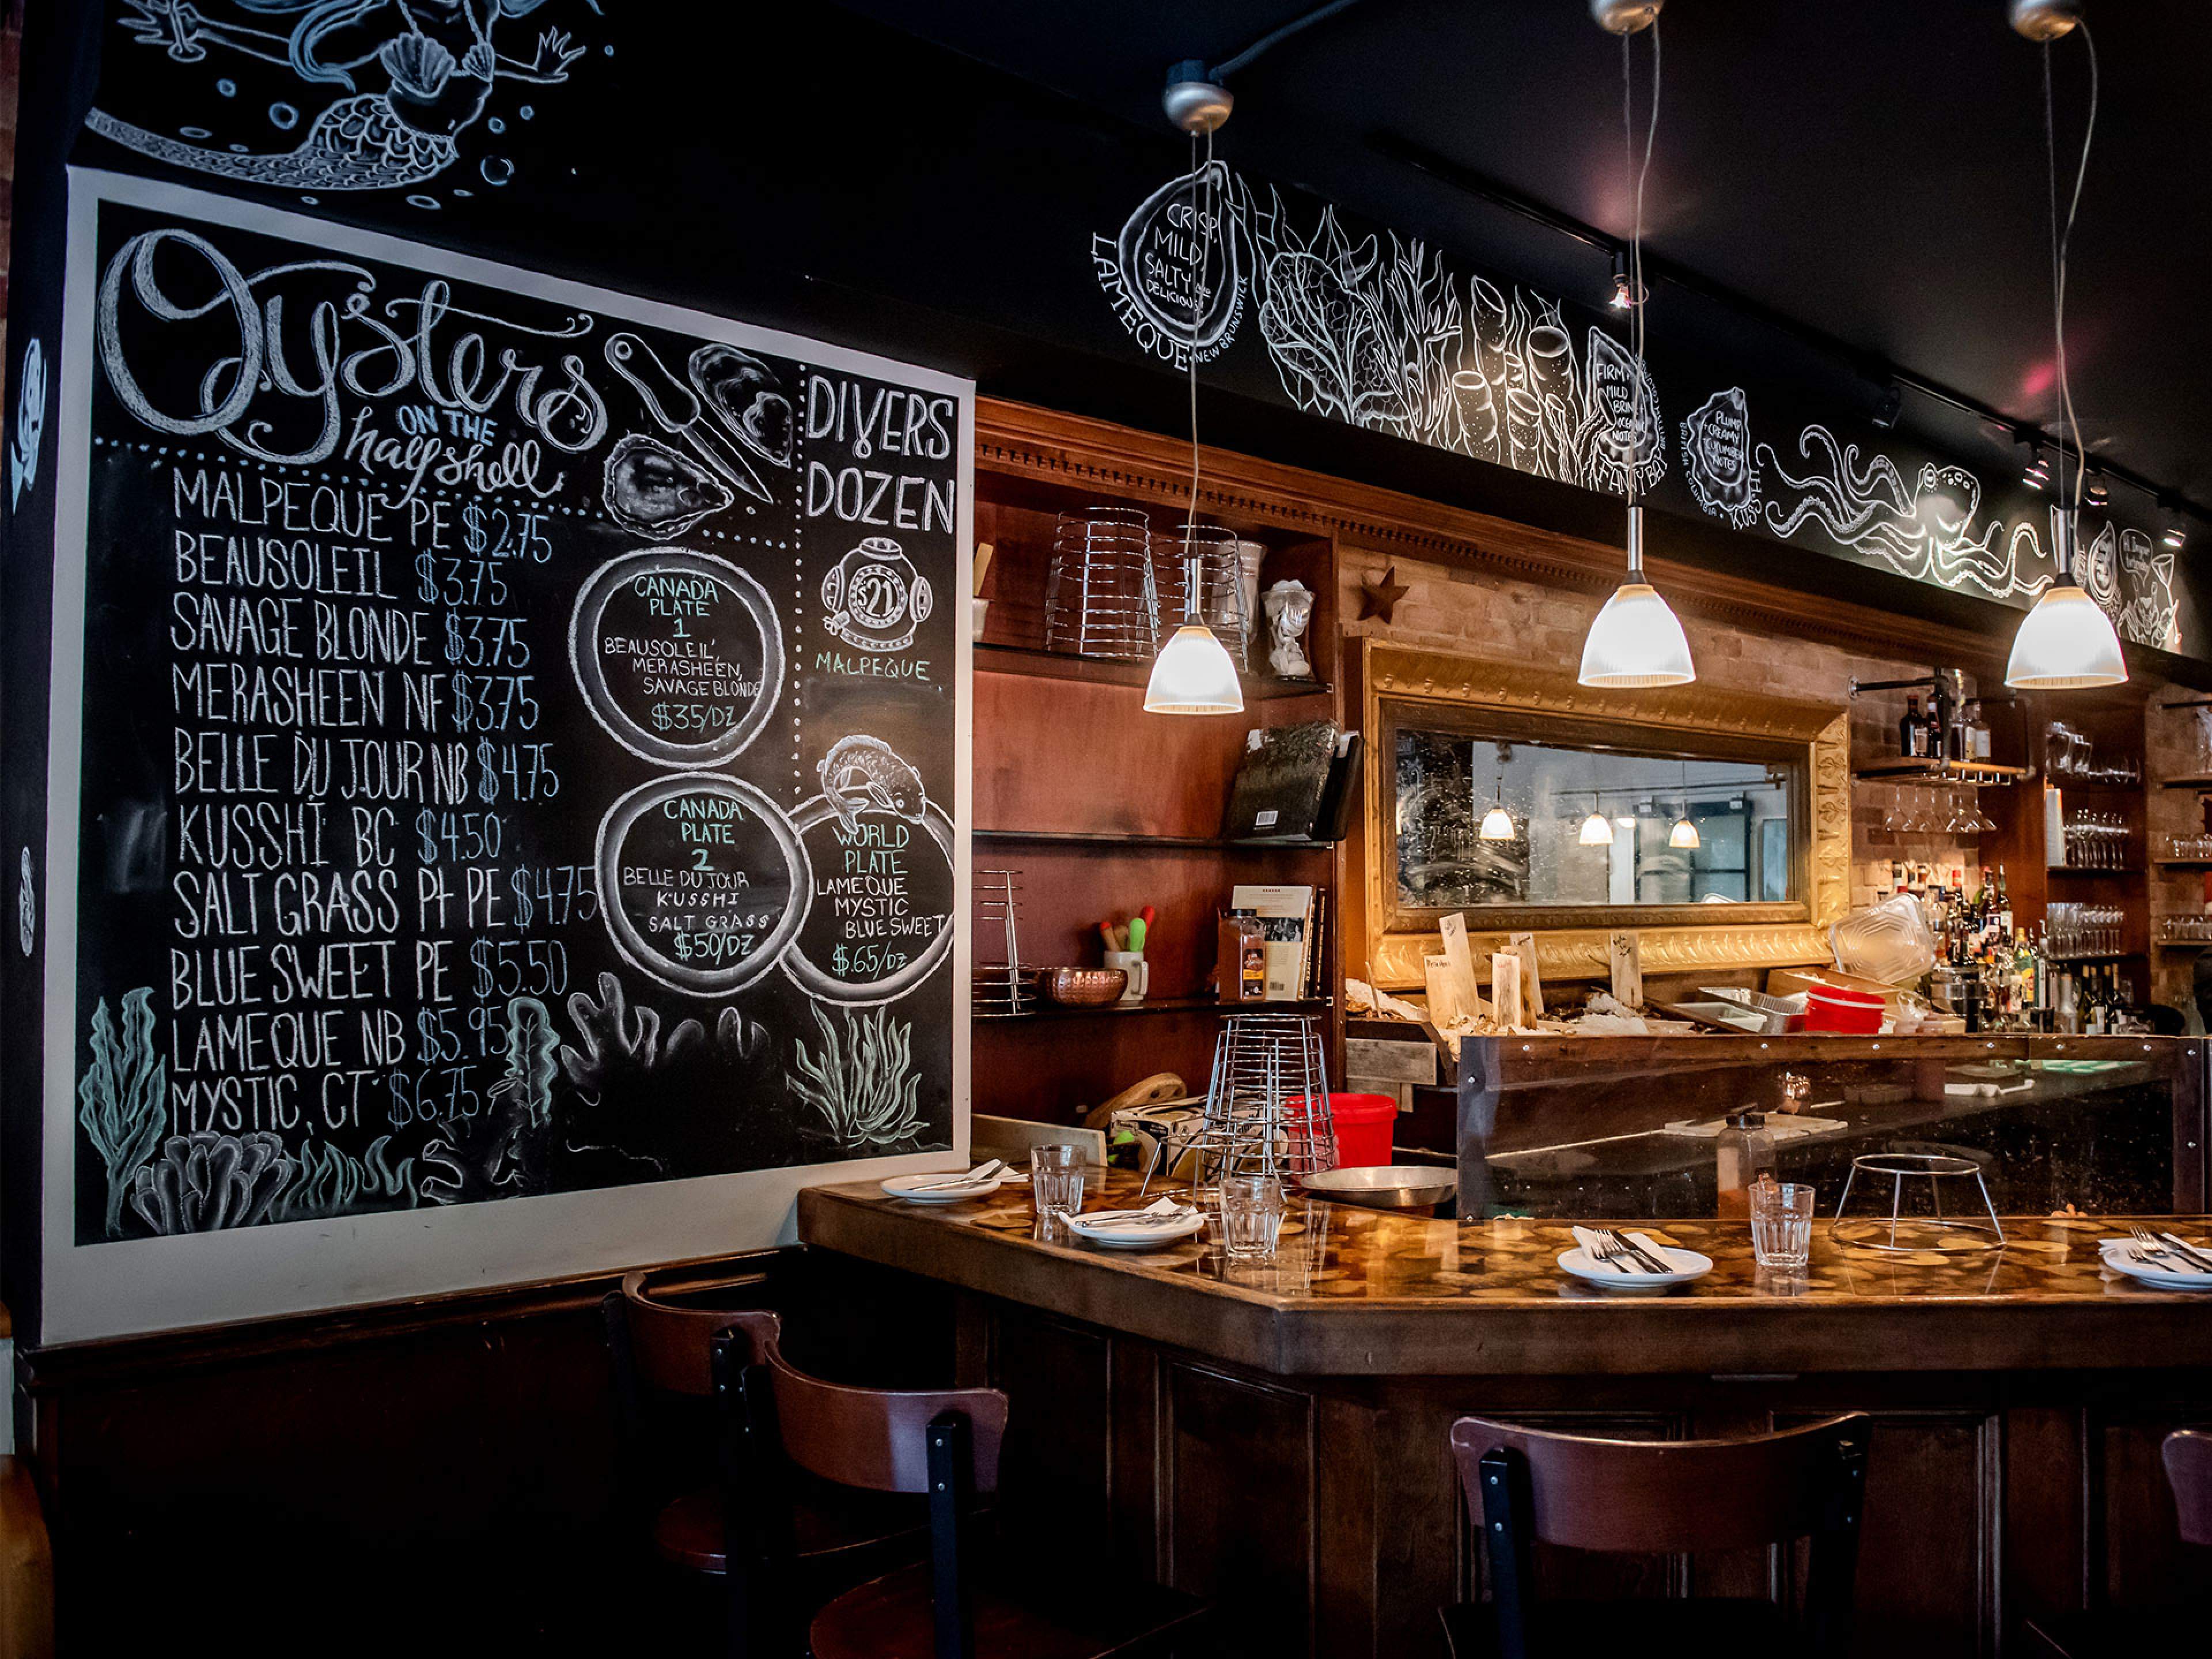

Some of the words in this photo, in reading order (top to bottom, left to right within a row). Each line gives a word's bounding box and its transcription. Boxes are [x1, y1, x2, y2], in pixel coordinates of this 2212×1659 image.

[1144, 252, 1192, 293] SALTY
[1090, 232, 1190, 373] LAMEQUE
[1195, 346, 1220, 364] NEW
[1218, 274, 1249, 350] BRUNSWICK
[97, 229, 609, 464] Oysters
[396, 404, 439, 437] ON
[443, 408, 498, 447] THE
[806, 374, 953, 460] DIVERS
[344, 406, 443, 509] half
[436, 439, 566, 499] shell
[173, 467, 392, 542] MALPEQUE
[410, 496, 452, 550] PE
[463, 501, 552, 563] $2.75
[806, 460, 955, 535] DOZEN
[175, 529, 398, 600] BEAUSOLEIL
[415, 548, 507, 606] $3.75
[634, 575, 719, 604] CANADA
[649, 599, 711, 618] PLATE
[858, 578, 895, 618] $21
[170, 592, 304, 658] SAVAGE
[314, 600, 433, 666] BLONDE
[444, 607, 531, 668] $3.75
[672, 618, 692, 638] 1
[815, 651, 931, 681] MALPEQUE
[172, 662, 385, 728] MERASHEEN
[404, 671, 447, 732] NF
[451, 669, 540, 733] $3.75
[642, 677, 710, 696] SAVAGE
[712, 680, 762, 698] BLONDE
[651, 701, 737, 733] $35/DZ
[174, 726, 279, 794] BELLE
[293, 732, 331, 798] DU
[340, 738, 425, 804] JOUR
[431, 741, 468, 805] NB
[476, 736, 559, 804] $4.75
[663, 797, 745, 821] CANADA
[178, 801, 329, 869] KUSSHI
[352, 806, 398, 868] BC
[415, 807, 502, 865] $4.50
[681, 821, 736, 845] PLATE
[831, 823, 910, 849] WORLD
[623, 866, 674, 887] BELLE
[679, 869, 703, 889] DU
[707, 871, 750, 891] JOUR
[691, 848, 715, 872] 2
[844, 849, 909, 875] PLATE
[173, 869, 264, 939] SALT
[274, 868, 399, 937] GRASS
[467, 868, 506, 930] PE
[510, 864, 598, 933] $4.75
[657, 889, 740, 908] KUSSHI
[816, 875, 909, 897] LAMEQUE
[648, 914, 696, 933] SALT
[705, 913, 770, 930] GRASS
[834, 897, 910, 918] MYSTIC
[844, 919, 888, 940] BLUE
[889, 914, 946, 938] SWEET
[171, 945, 262, 1011] BLUE
[270, 940, 397, 1005] SWEET
[415, 940, 454, 1002] PE
[469, 935, 567, 1004] $5.50
[172, 1010, 343, 1072] LAMEQUE
[361, 1009, 406, 1066] NB
[417, 1006, 511, 1065] $5.95
[322, 1070, 376, 1131] CT
[388, 1066, 479, 1132] $6.75
